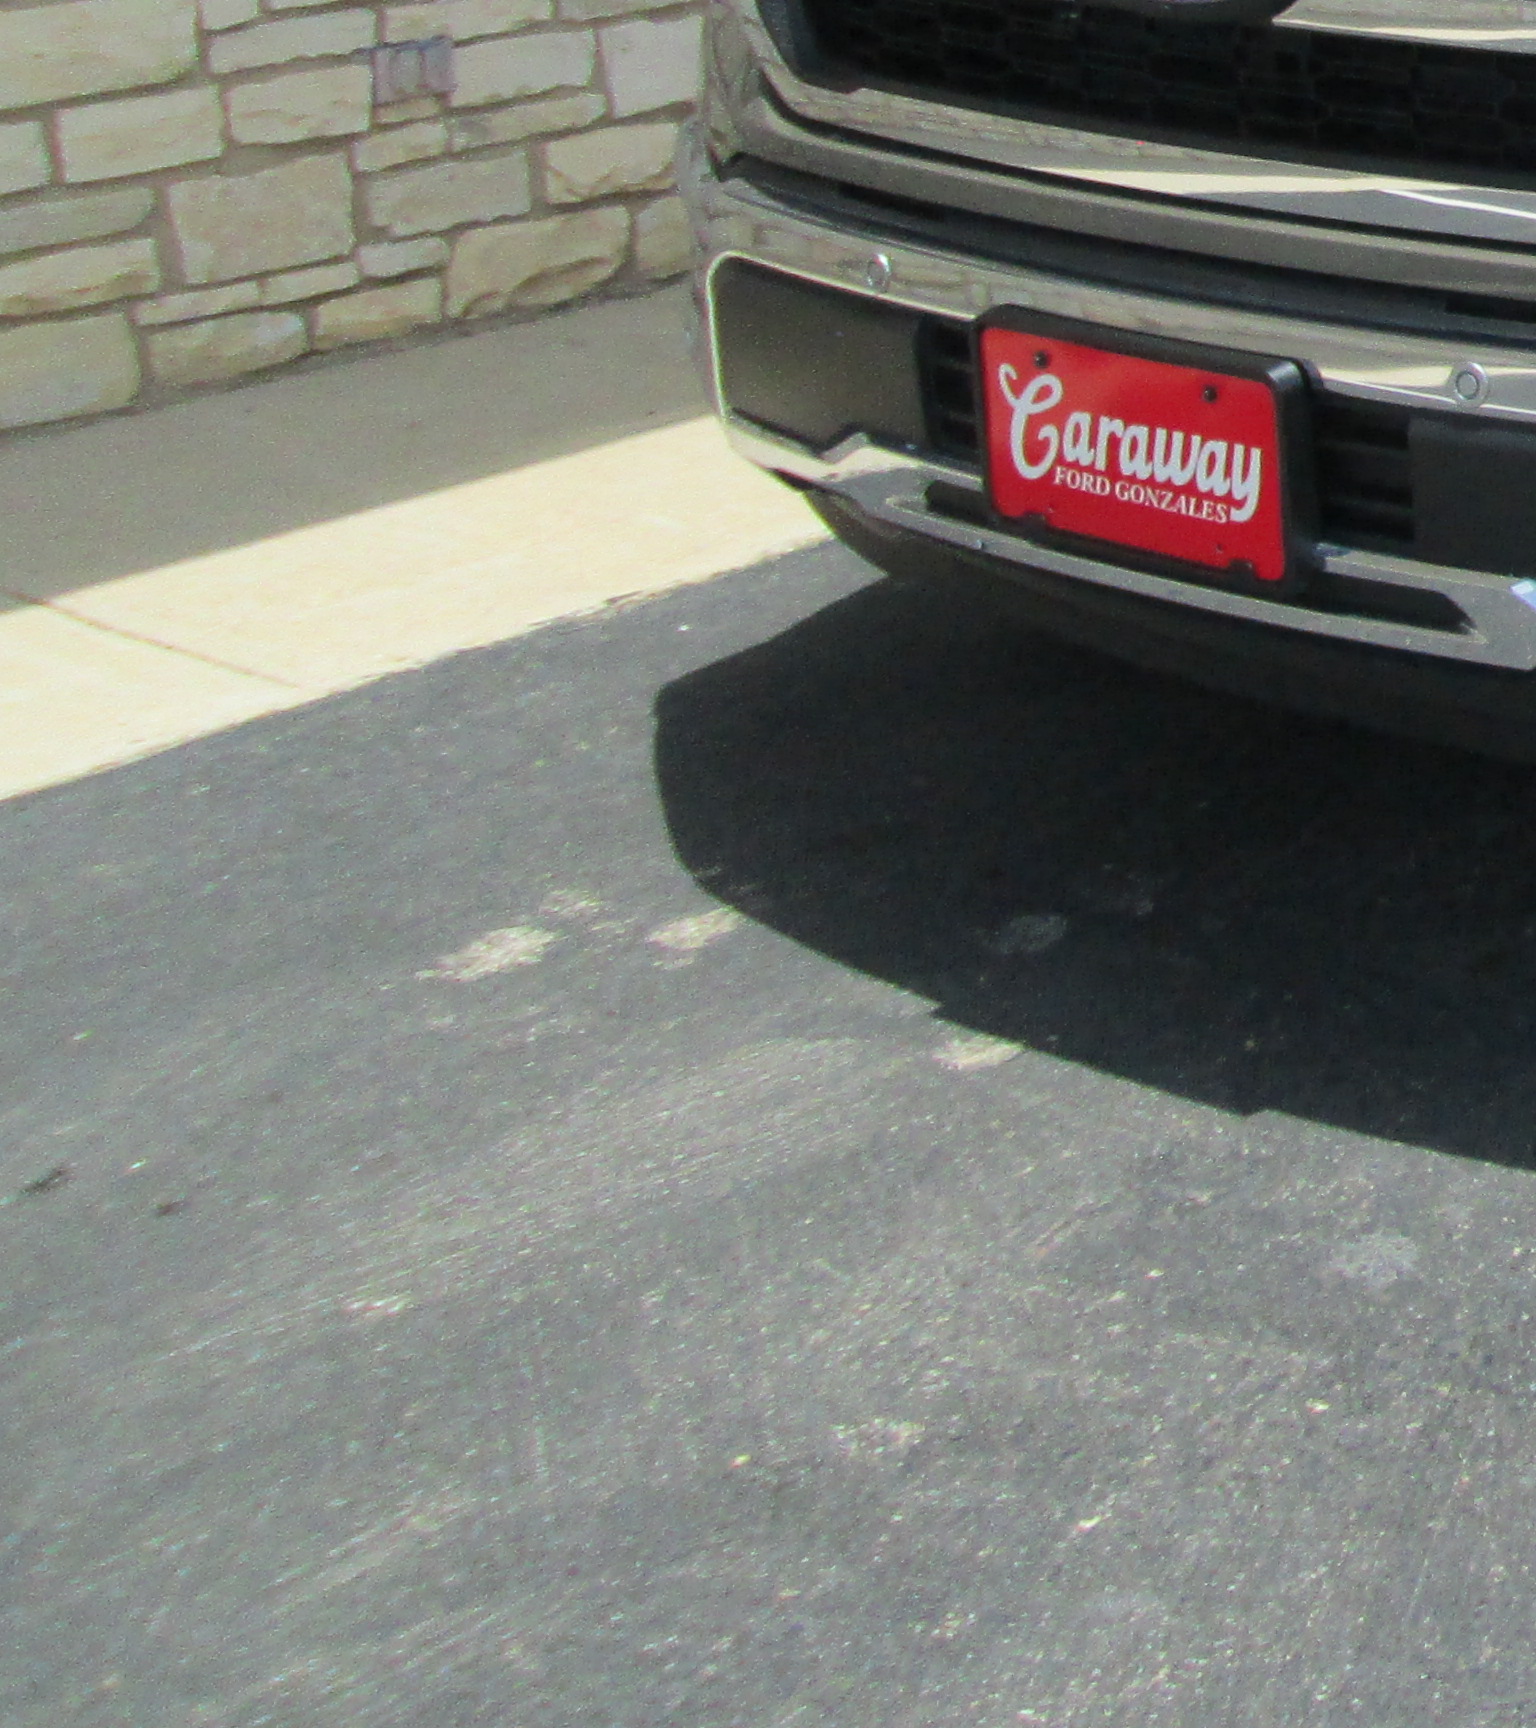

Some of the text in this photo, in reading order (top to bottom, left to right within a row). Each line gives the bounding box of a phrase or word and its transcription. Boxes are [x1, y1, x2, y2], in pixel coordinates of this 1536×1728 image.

[999, 363, 1262, 522] Caraway
[1053, 466, 1231, 523] FORD GONZALES
